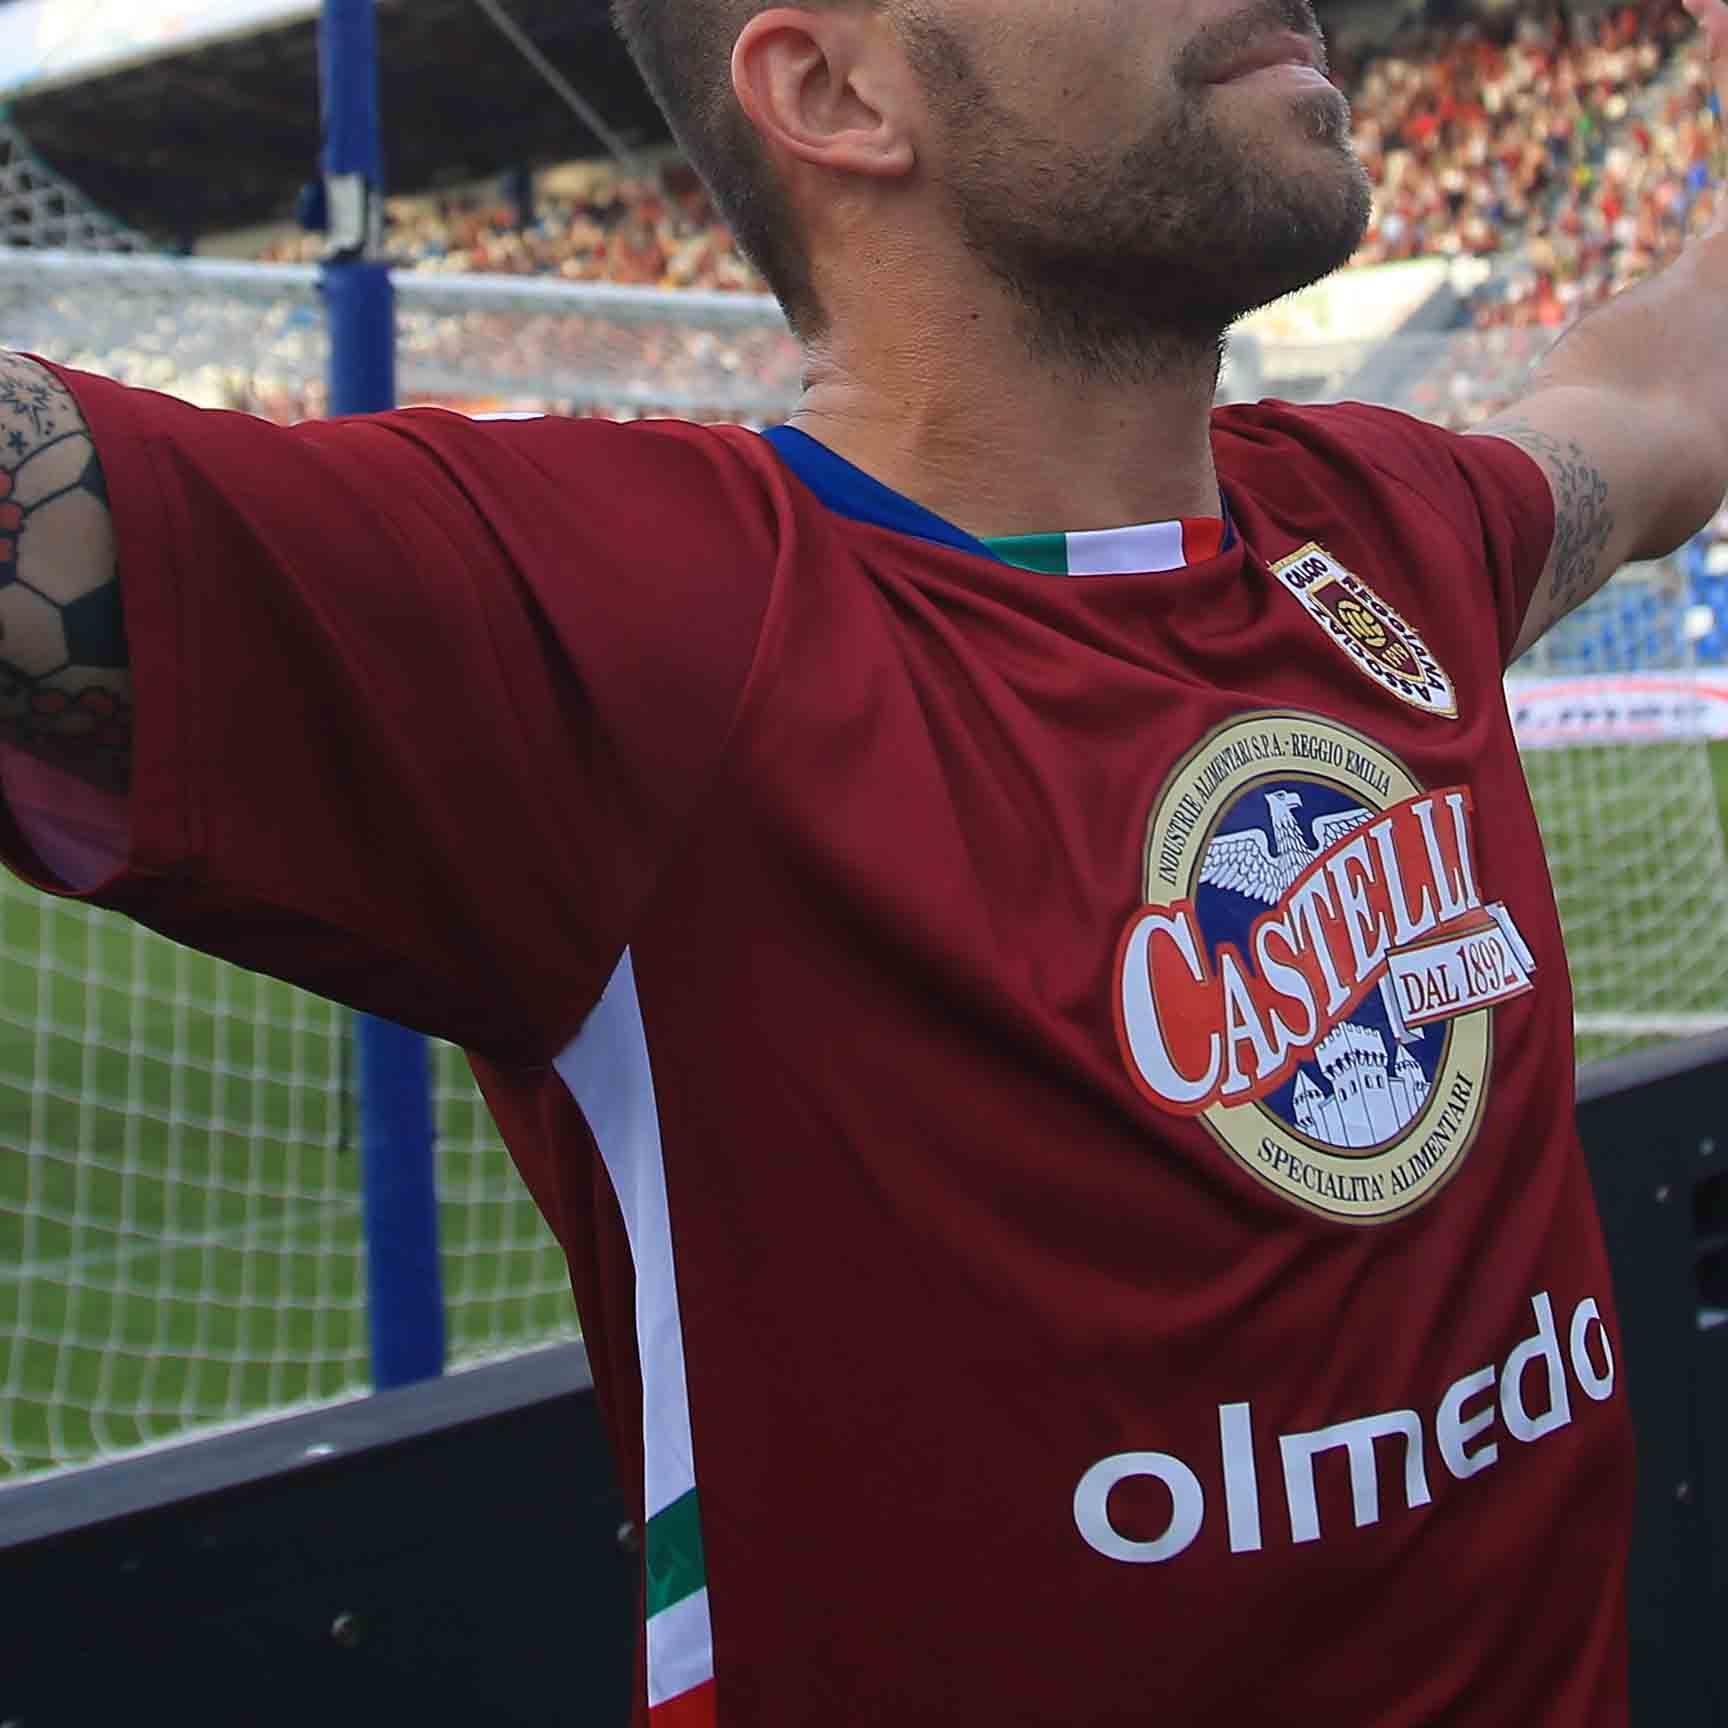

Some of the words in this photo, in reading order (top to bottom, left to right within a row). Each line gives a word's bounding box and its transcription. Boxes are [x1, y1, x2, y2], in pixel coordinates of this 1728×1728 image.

[1341, 575, 1445, 693] REGGIANA
[1158, 793, 1202, 886] INDUSTRIE
[1192, 737, 1252, 806] ALIMENTARI
[1247, 732, 1286, 760] S.P.A.
[1290, 732, 1344, 767] REGGIO
[1344, 749, 1392, 797] EMILIA
[1122, 793, 1481, 1104] CASTELLI
[1399, 963, 1460, 1015] DAL
[1455, 936, 1518, 999] 1892
[1390, 1071, 1474, 1196] ALIMENTARI
[1073, 1290, 1615, 1563] olmedo
